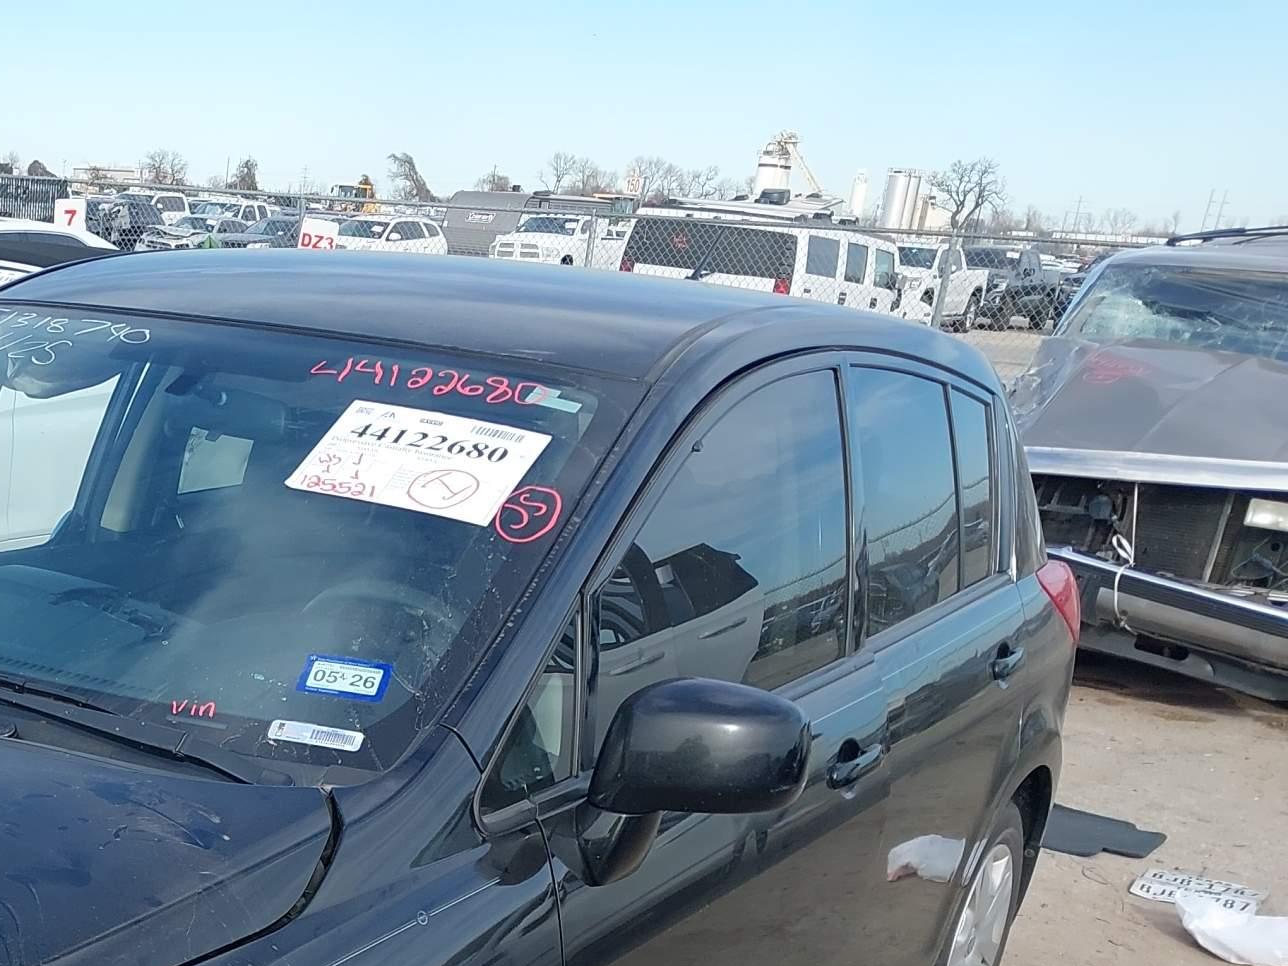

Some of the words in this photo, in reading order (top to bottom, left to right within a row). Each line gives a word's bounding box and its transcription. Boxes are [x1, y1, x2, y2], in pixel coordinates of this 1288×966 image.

[64, 209, 77, 226] 7
[300, 232, 334, 249] DZ3
[310, 357, 549, 405] 44122680
[350, 423, 508, 463] 44122680
[301, 474, 376, 497] 125521
[313, 669, 339, 684] 05
[349, 673, 377, 690] 26
